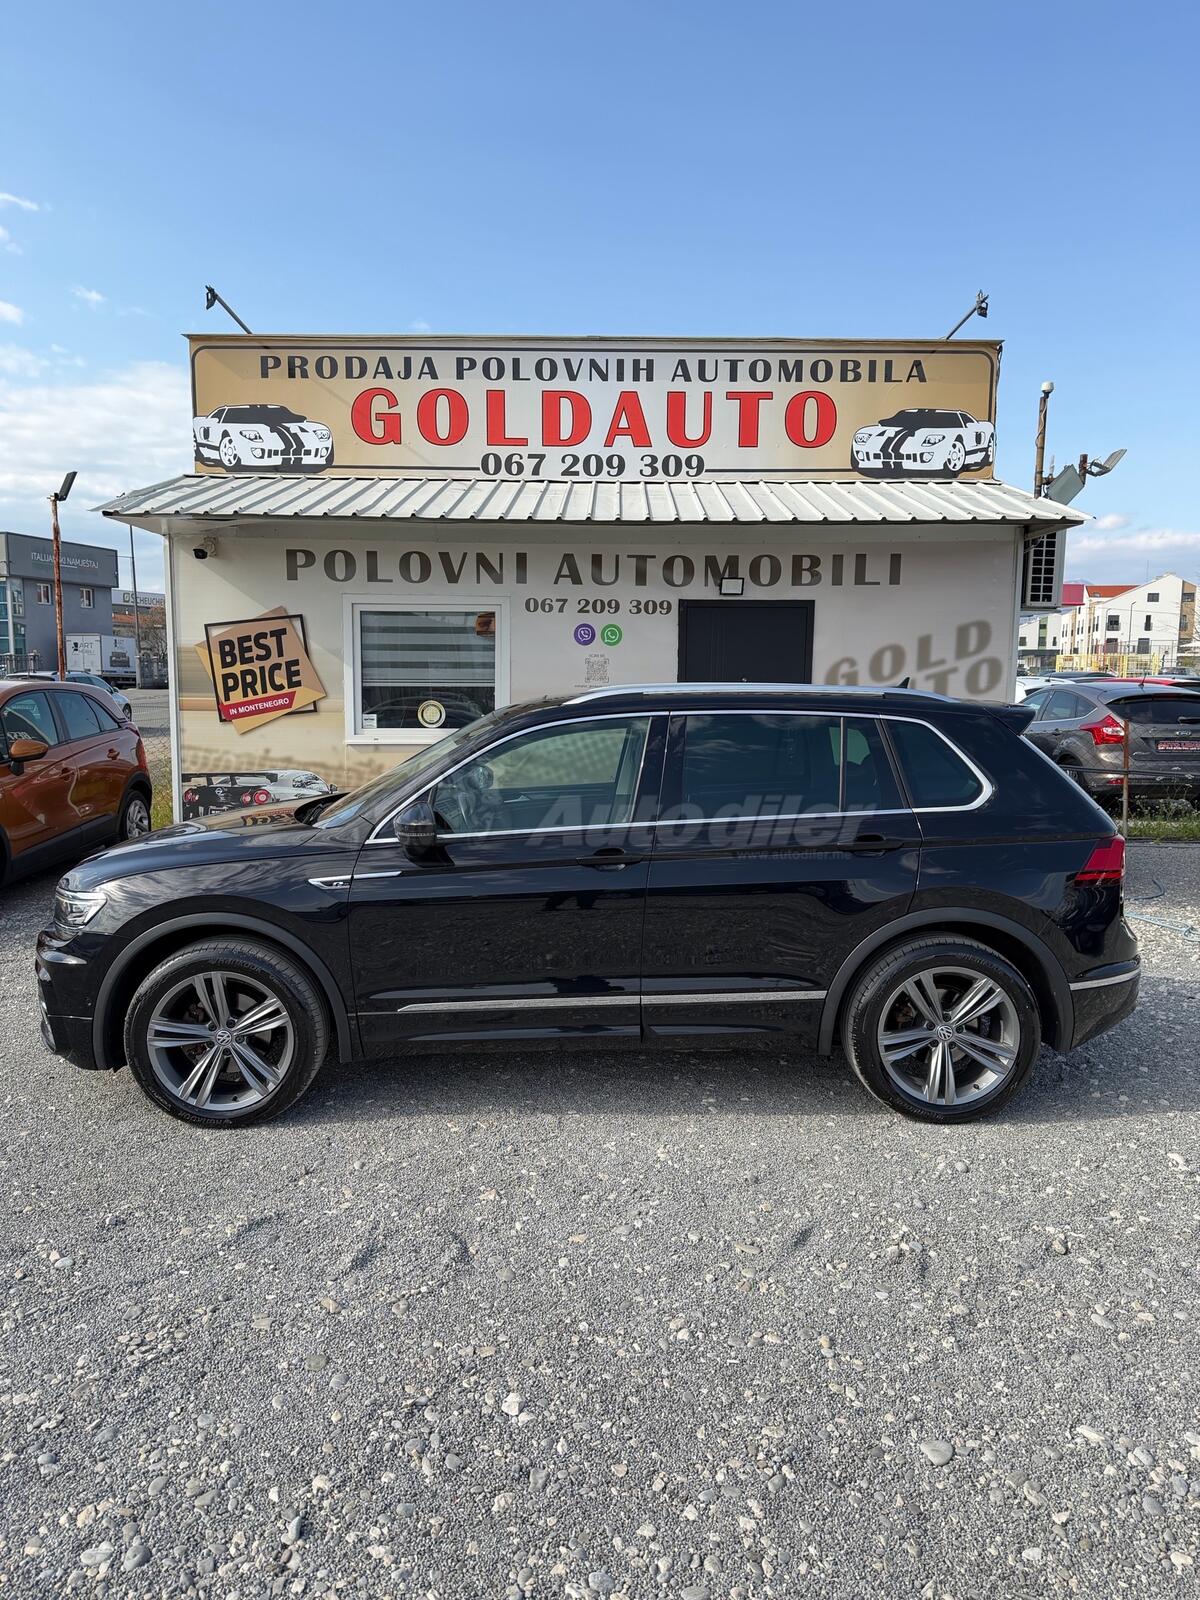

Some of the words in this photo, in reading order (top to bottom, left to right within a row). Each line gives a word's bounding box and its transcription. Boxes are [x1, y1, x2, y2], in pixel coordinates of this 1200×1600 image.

[260, 355, 439, 380] PRODAJA
[456, 357, 655, 382] POLOVNIH
[671, 358, 927, 383] AUTOMOBILA
[351, 387, 837, 448] GOLDAUTO
[480, 453, 546, 477] 067
[560, 453, 626, 478] 209
[639, 454, 705, 478] 309
[286, 549, 527, 585] POLOVNI
[553, 553, 902, 588] AUTOMOBILI
[525, 597, 568, 613] 067
[577, 598, 621, 614] 209
[629, 599, 672, 615] 309
[218, 627, 287, 669] BEST
[824, 619, 992, 686] GOLD
[221, 659, 302, 702] PRICE
[229, 707, 238, 716] IN
[238, 697, 289, 714] MONTENEGRO
